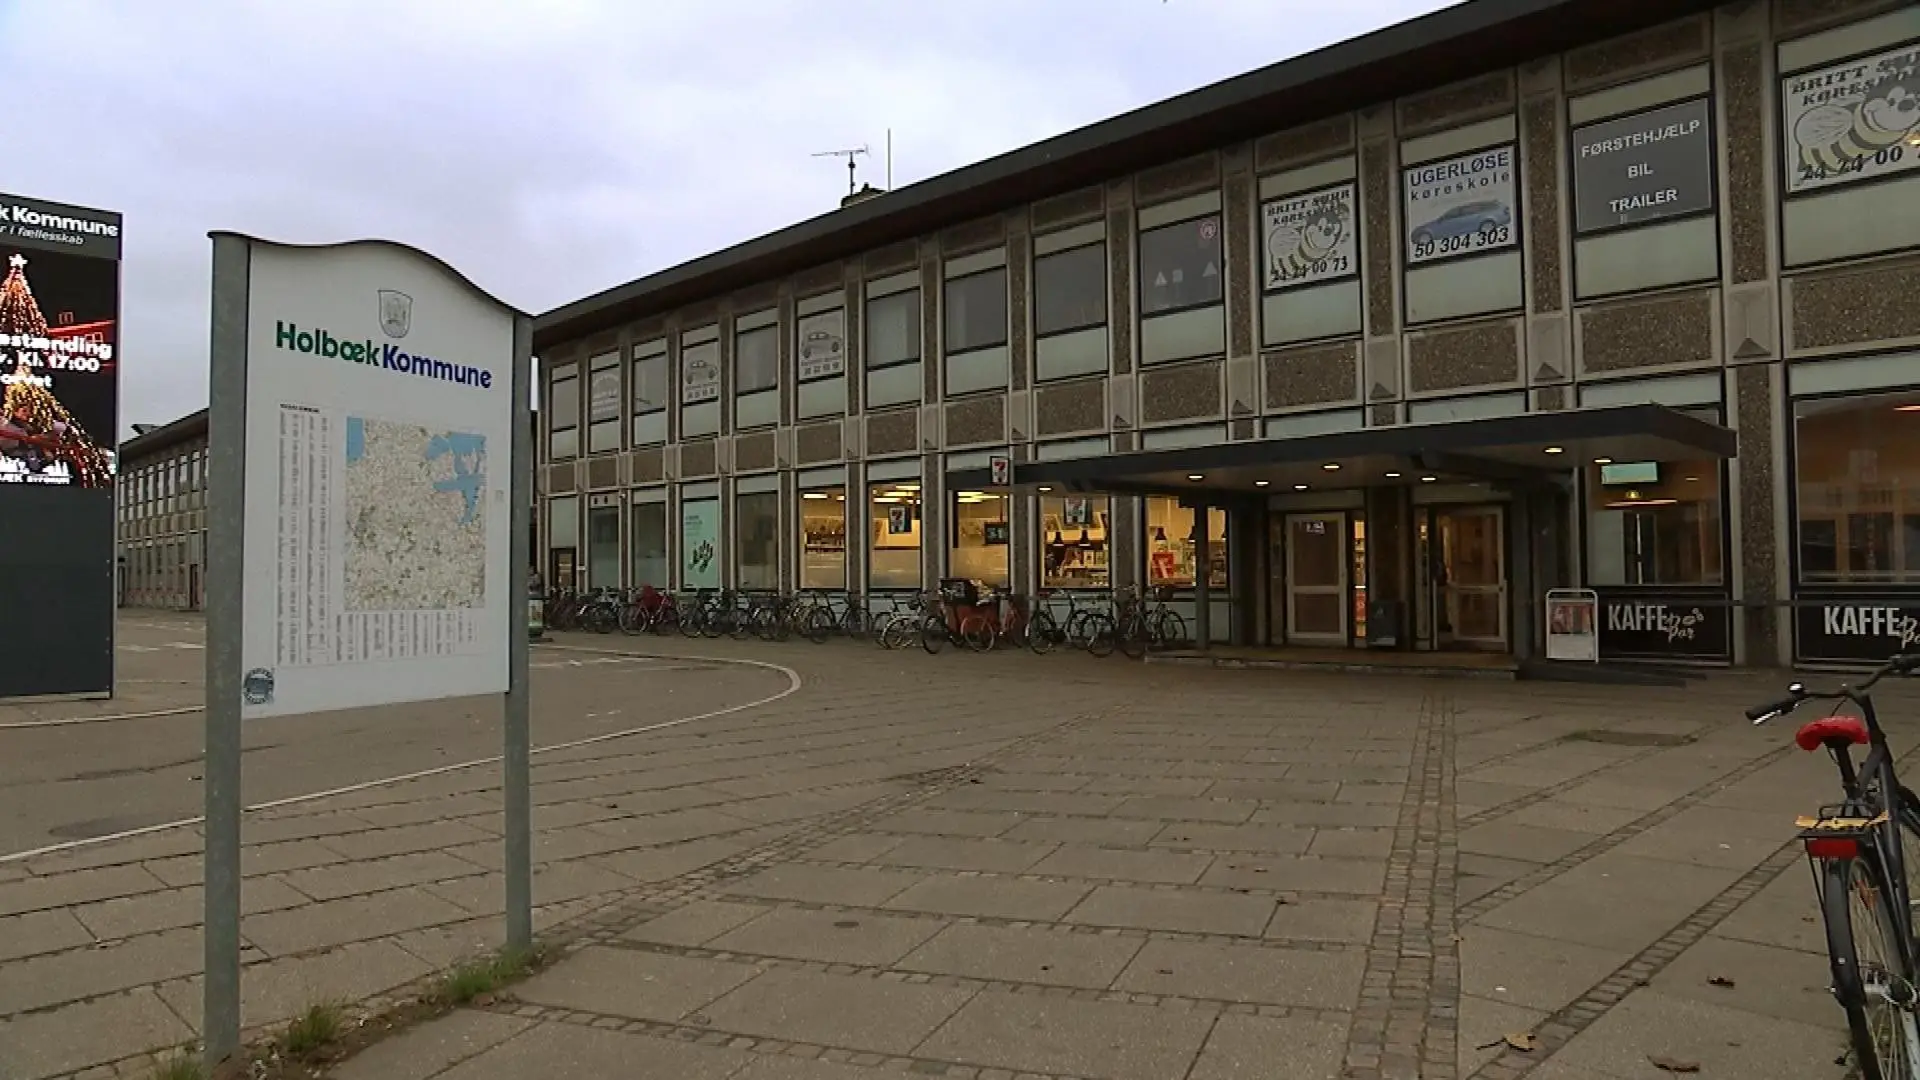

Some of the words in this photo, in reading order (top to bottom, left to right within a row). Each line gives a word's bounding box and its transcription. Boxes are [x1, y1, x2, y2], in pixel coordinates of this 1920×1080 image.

[1792, 65, 1868, 95] BRITT
[1581, 119, 1701, 159] FØRSTEHJÆLP
[1410, 151, 1509, 187] UGERLØSE
[1628, 162, 1654, 179] BIL
[1875, 146, 1903, 165] 00
[1411, 171, 1510, 201] køreskole
[1609, 188, 1679, 213] TRAILER
[12, 205, 119, 237] Kommune
[1415, 241, 1435, 258] 50
[1440, 232, 1471, 253] 304
[1476, 227, 1509, 248] 303
[1312, 259, 1327, 274] 00
[1332, 255, 1348, 272] 73
[48, 354, 100, 372] 17:00
[276, 320, 380, 367] Holbæk
[382, 344, 493, 389] Kommune
[1608, 604, 1667, 631] KAFFE
[1824, 606, 1900, 636] KAFFE
